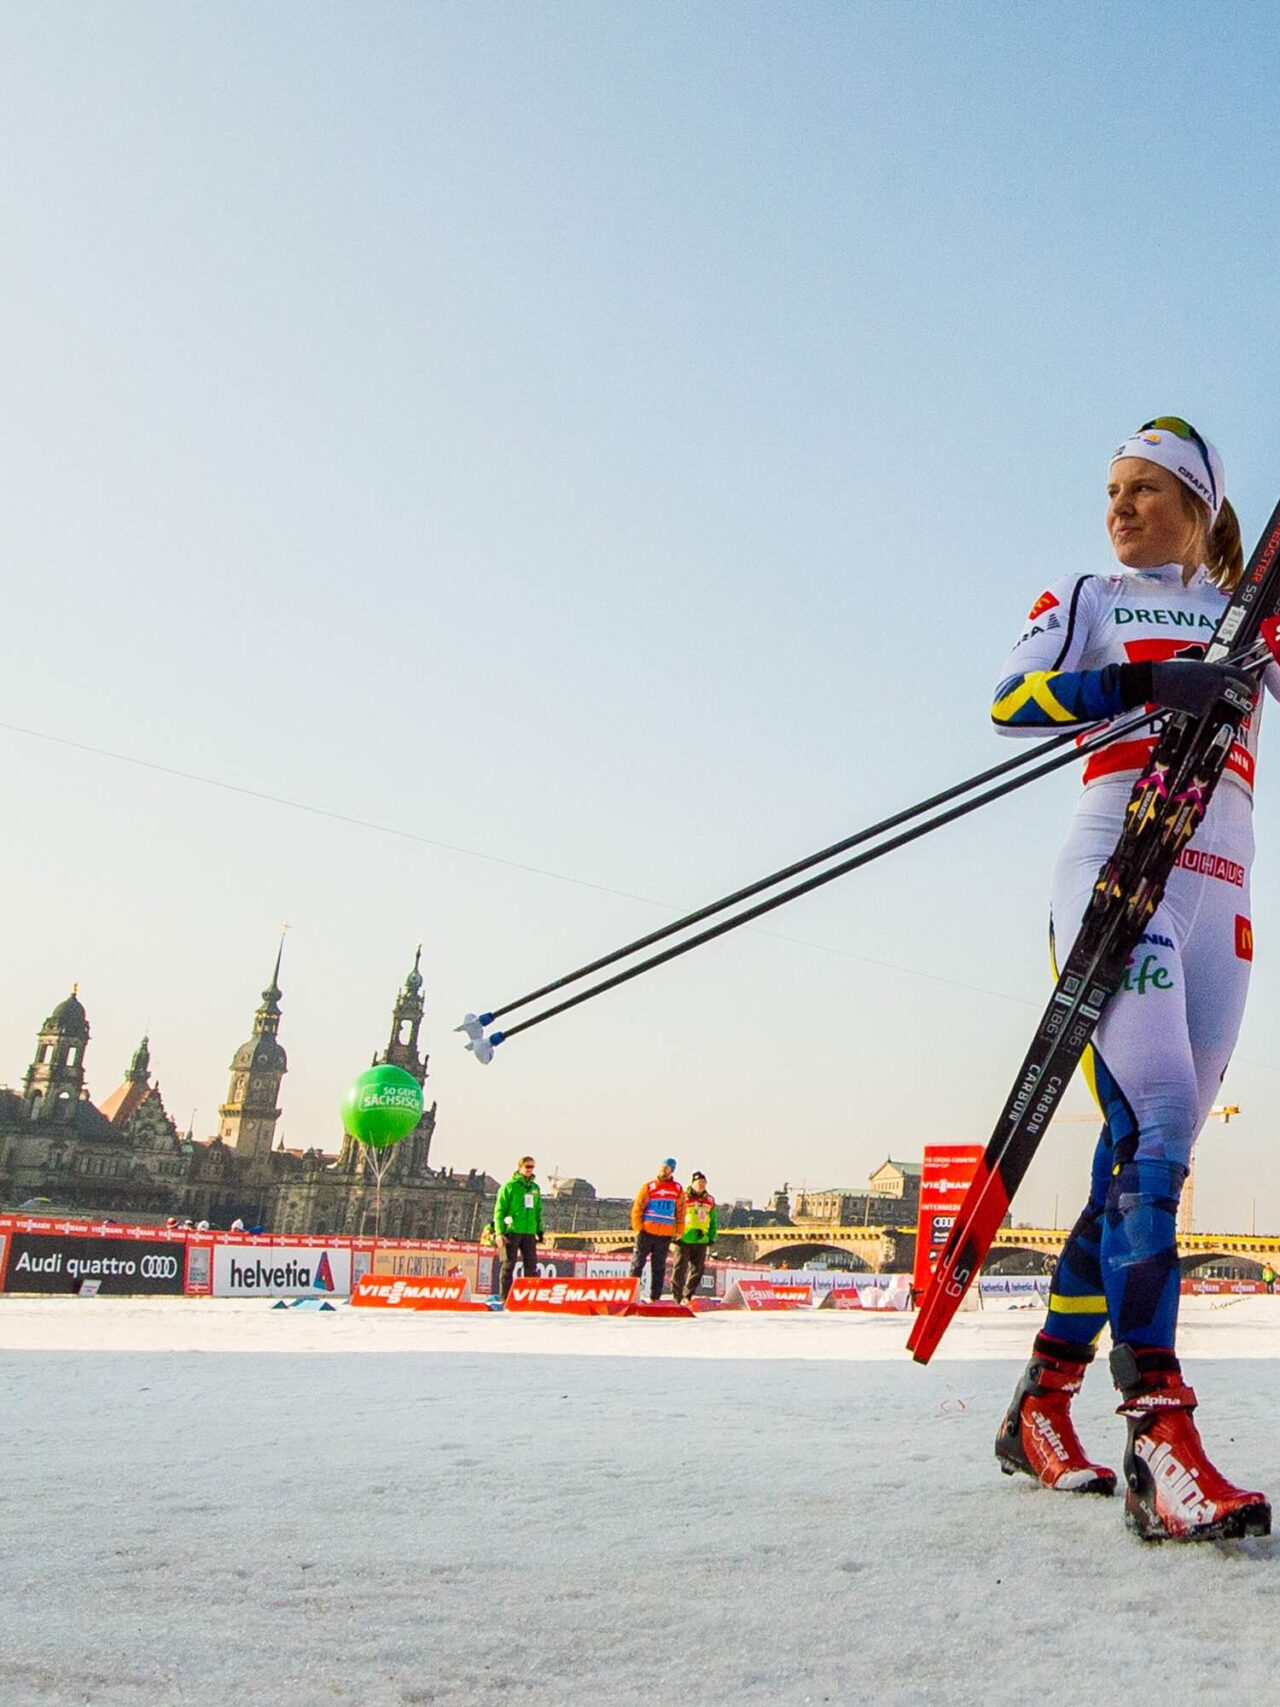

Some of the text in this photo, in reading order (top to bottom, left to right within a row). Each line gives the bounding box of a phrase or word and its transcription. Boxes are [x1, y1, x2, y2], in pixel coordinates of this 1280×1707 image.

[1178, 466, 1209, 495] CRAFT
[1241, 584, 1258, 602] S9
[1115, 607, 1220, 632] DREWA
[1224, 687, 1254, 711] GUID
[1176, 850, 1244, 887] UHAUS
[363, 1093, 420, 1109] SÄCHSISC
[383, 1086, 396, 1097] SO
[1008, 1063, 1040, 1122] CARBON
[1027, 1076, 1061, 1134] CARBON
[922, 1179, 972, 1193] VIESSMAN
[15, 1252, 136, 1278] Audi quattro
[230, 1259, 310, 1288] helvetia
[360, 1281, 460, 1304] VIESSMANN
[512, 1283, 632, 1304] VIESSMANN
[1136, 1395, 1181, 1408] alpina
[1031, 1411, 1069, 1462] alpina
[1135, 1434, 1217, 1526] alpina
